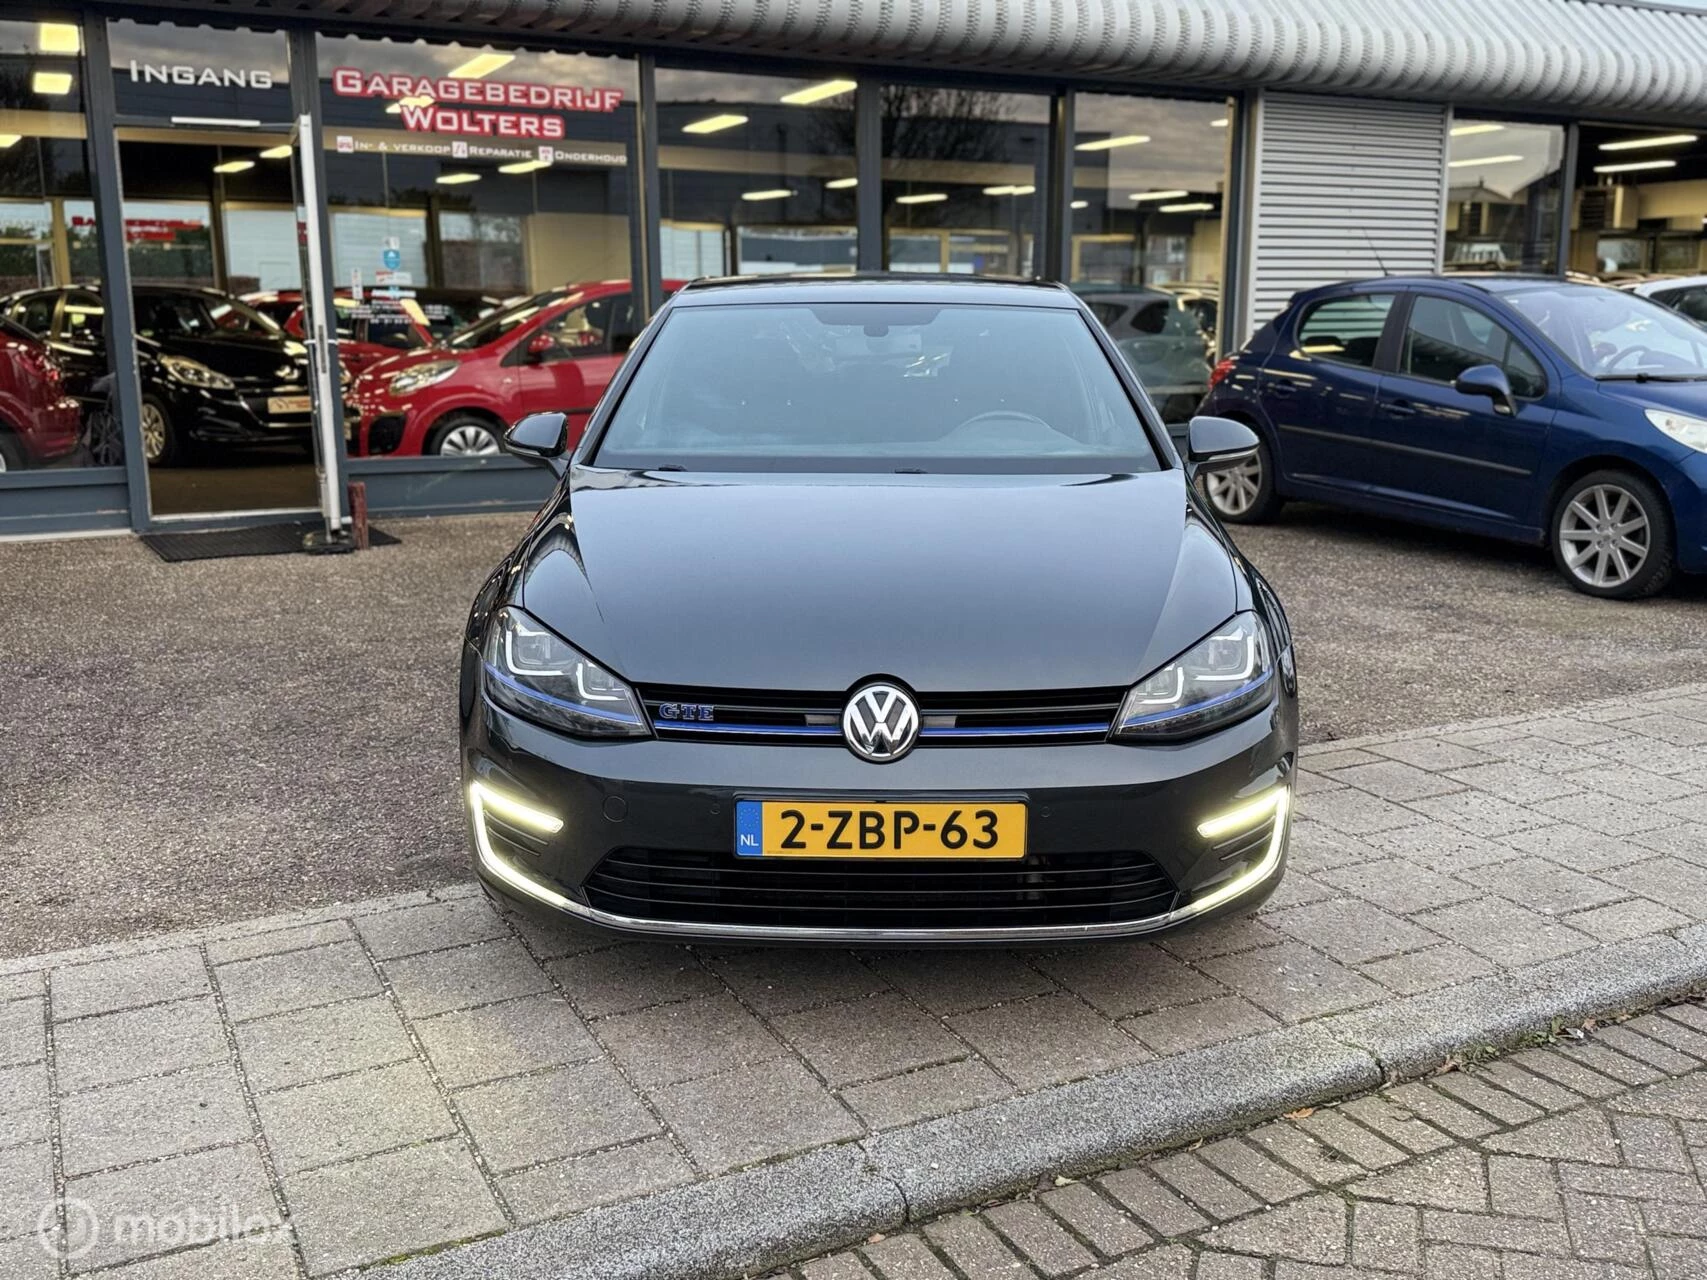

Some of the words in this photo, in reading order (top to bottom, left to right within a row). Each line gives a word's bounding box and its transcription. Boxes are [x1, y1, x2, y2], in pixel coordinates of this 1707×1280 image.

[334, 68, 622, 110] GARAGEBEDRIJF
[402, 106, 563, 137] WOLTERS
[378, 141, 388, 152] &
[659, 702, 715, 721] GTE
[740, 834, 759, 847] NL
[780, 809, 999, 850] 2-ZBP-63
